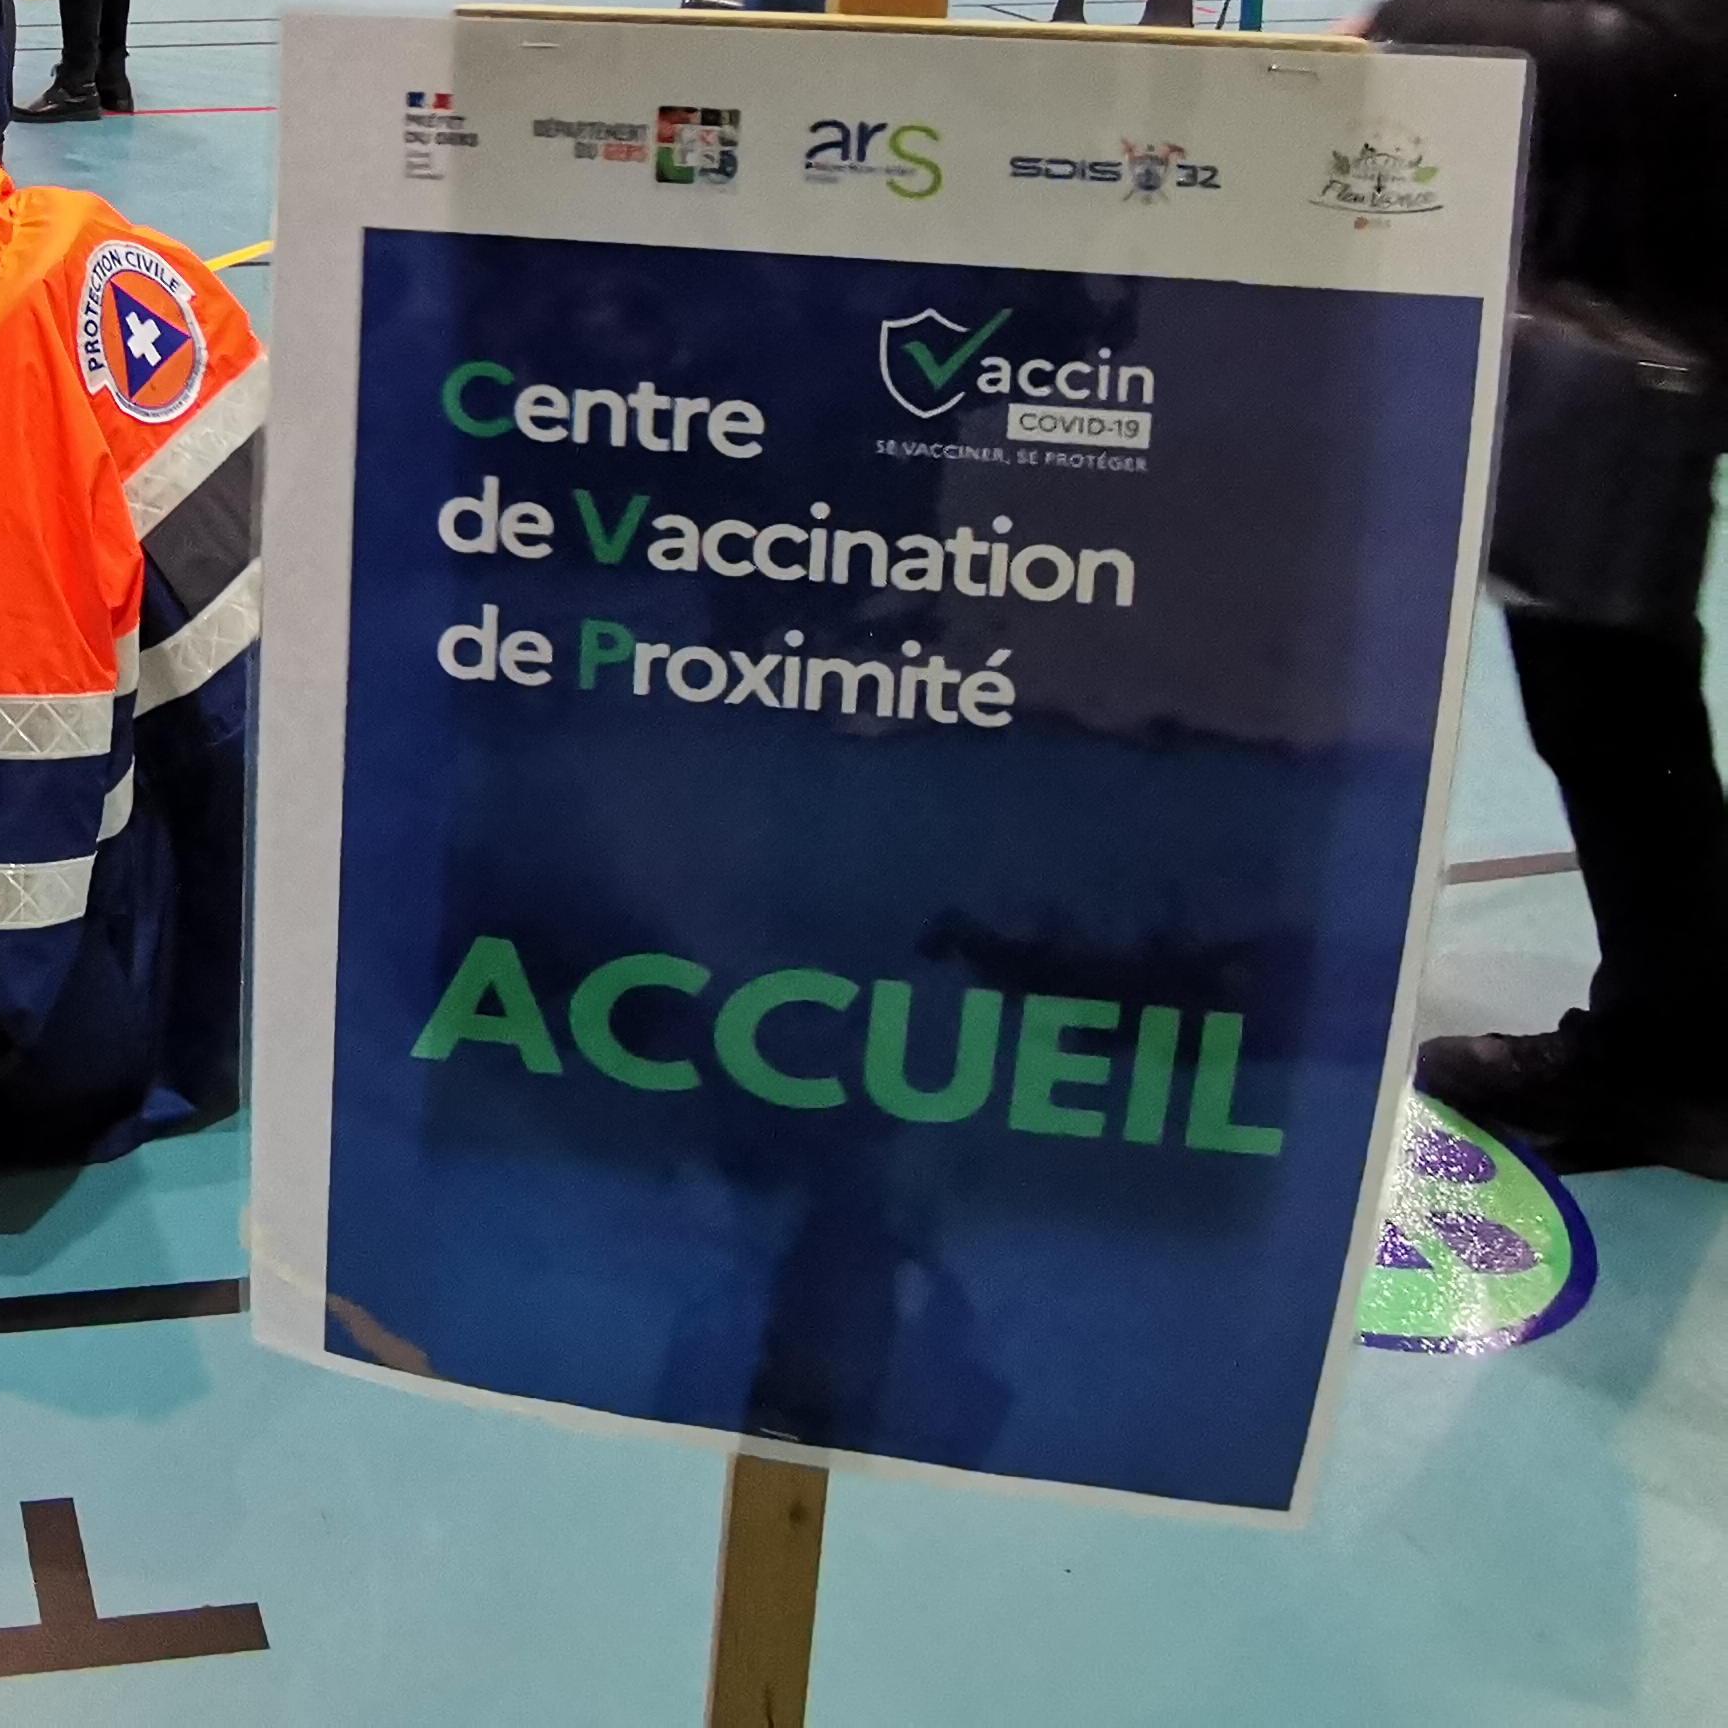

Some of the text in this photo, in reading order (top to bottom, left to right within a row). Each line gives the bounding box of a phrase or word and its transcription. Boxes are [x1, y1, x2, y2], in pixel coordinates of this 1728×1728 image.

[83, 249, 180, 372] PROTECTION CIVILE
[441, 360, 766, 460] Centre
[1018, 412, 1140, 440] COVID-19
[437, 475, 1137, 608] de Vaccination
[437, 603, 1017, 729] de Proximité
[410, 934, 1285, 1158] ACCUEIL
